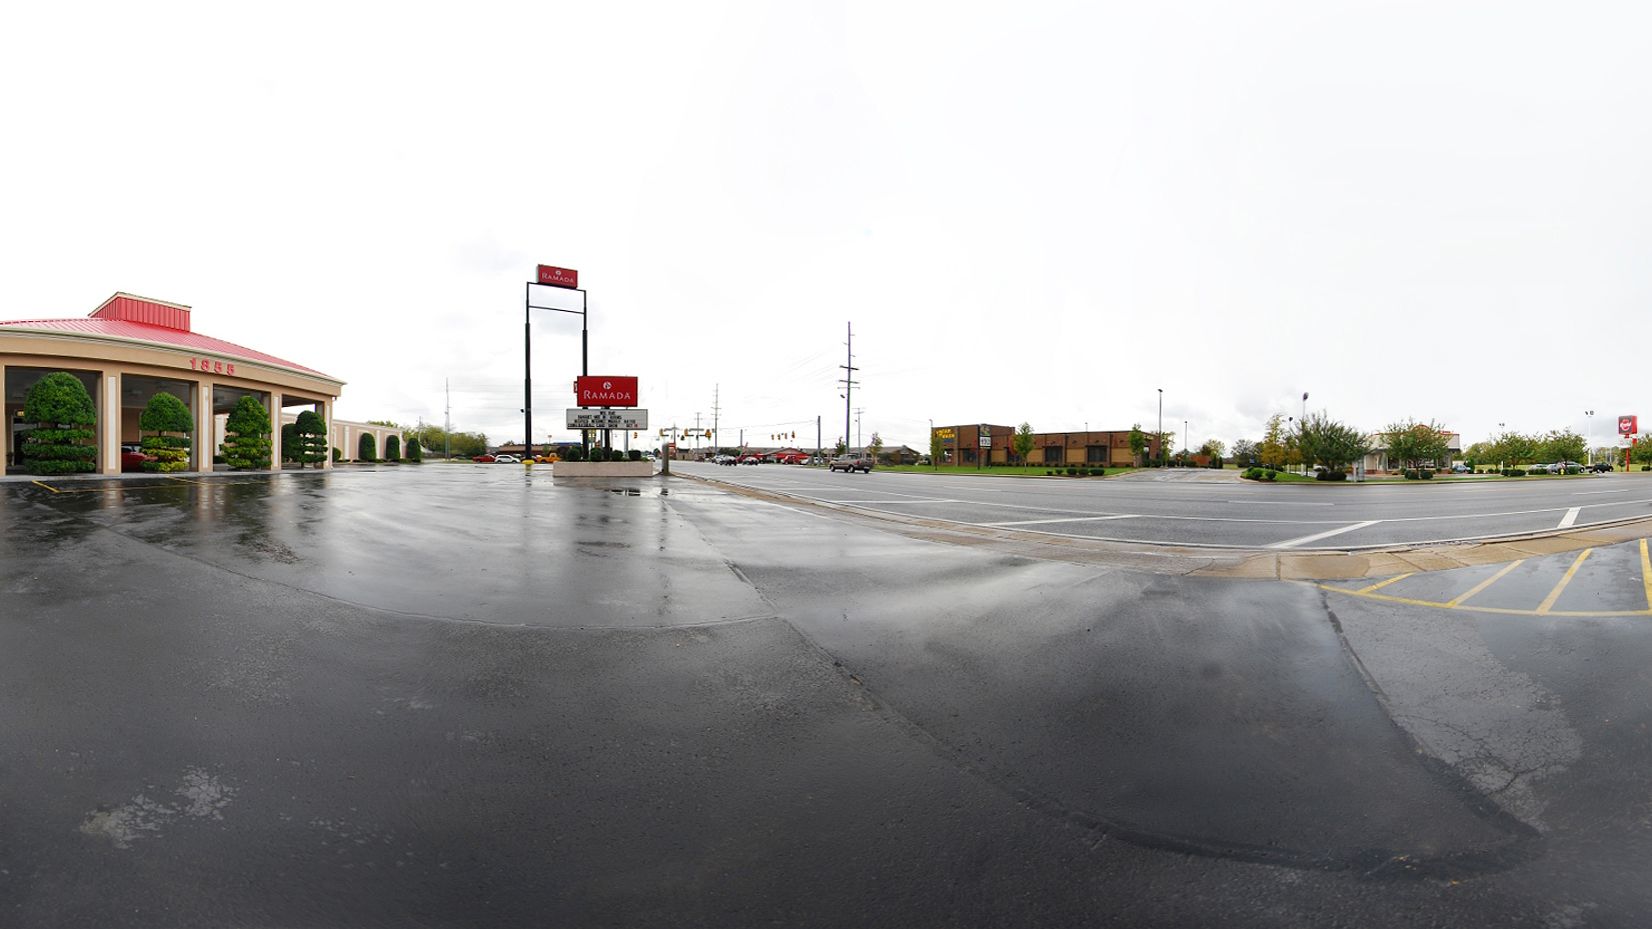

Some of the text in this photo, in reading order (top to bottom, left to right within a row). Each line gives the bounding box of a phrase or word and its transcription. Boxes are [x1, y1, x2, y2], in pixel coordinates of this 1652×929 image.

[542, 272, 574, 283] RAMADA
[190, 356, 235, 376] 1855
[583, 390, 631, 400] RAMADA
